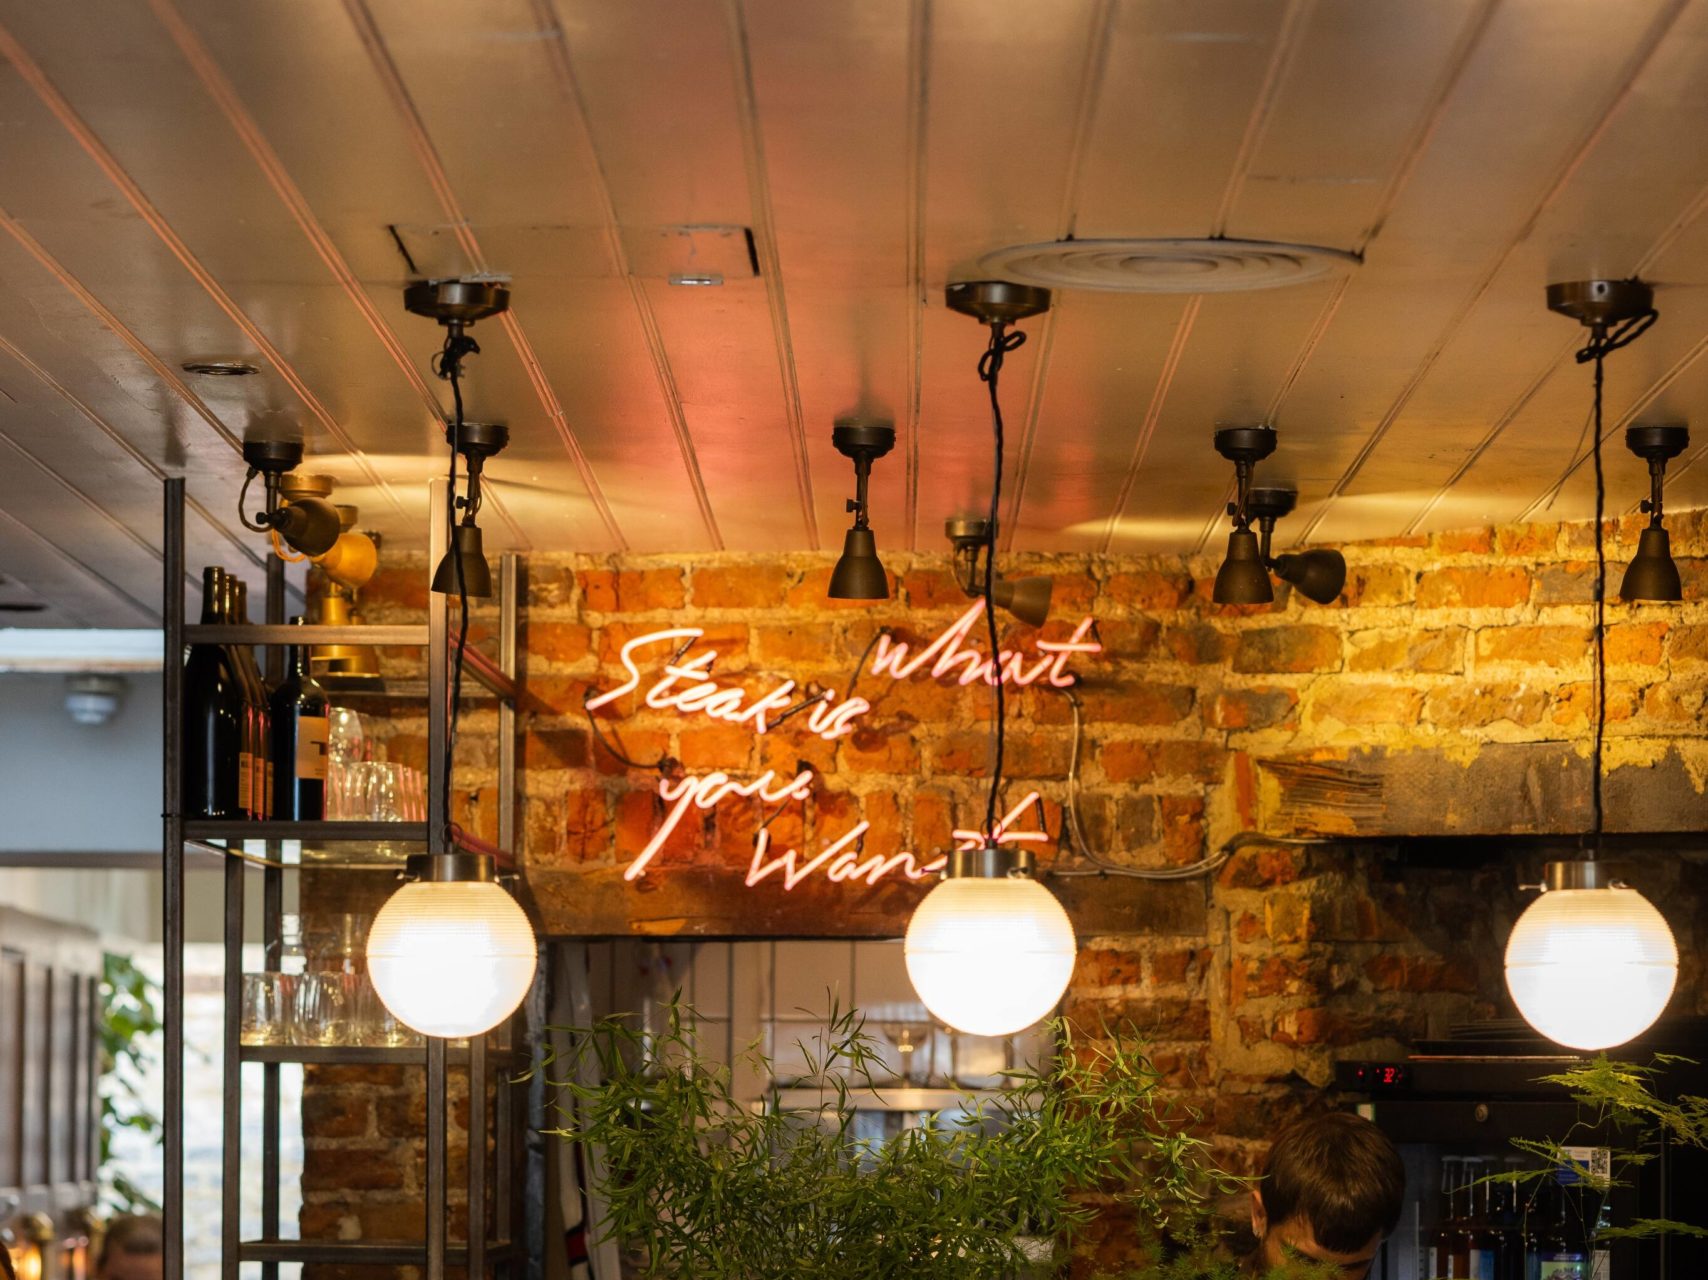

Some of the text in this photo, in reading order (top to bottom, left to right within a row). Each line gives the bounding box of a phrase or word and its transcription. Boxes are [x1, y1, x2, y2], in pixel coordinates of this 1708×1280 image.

[585, 627, 795, 734] Steak
[808, 688, 870, 740] is
[624, 770, 813, 881] you
